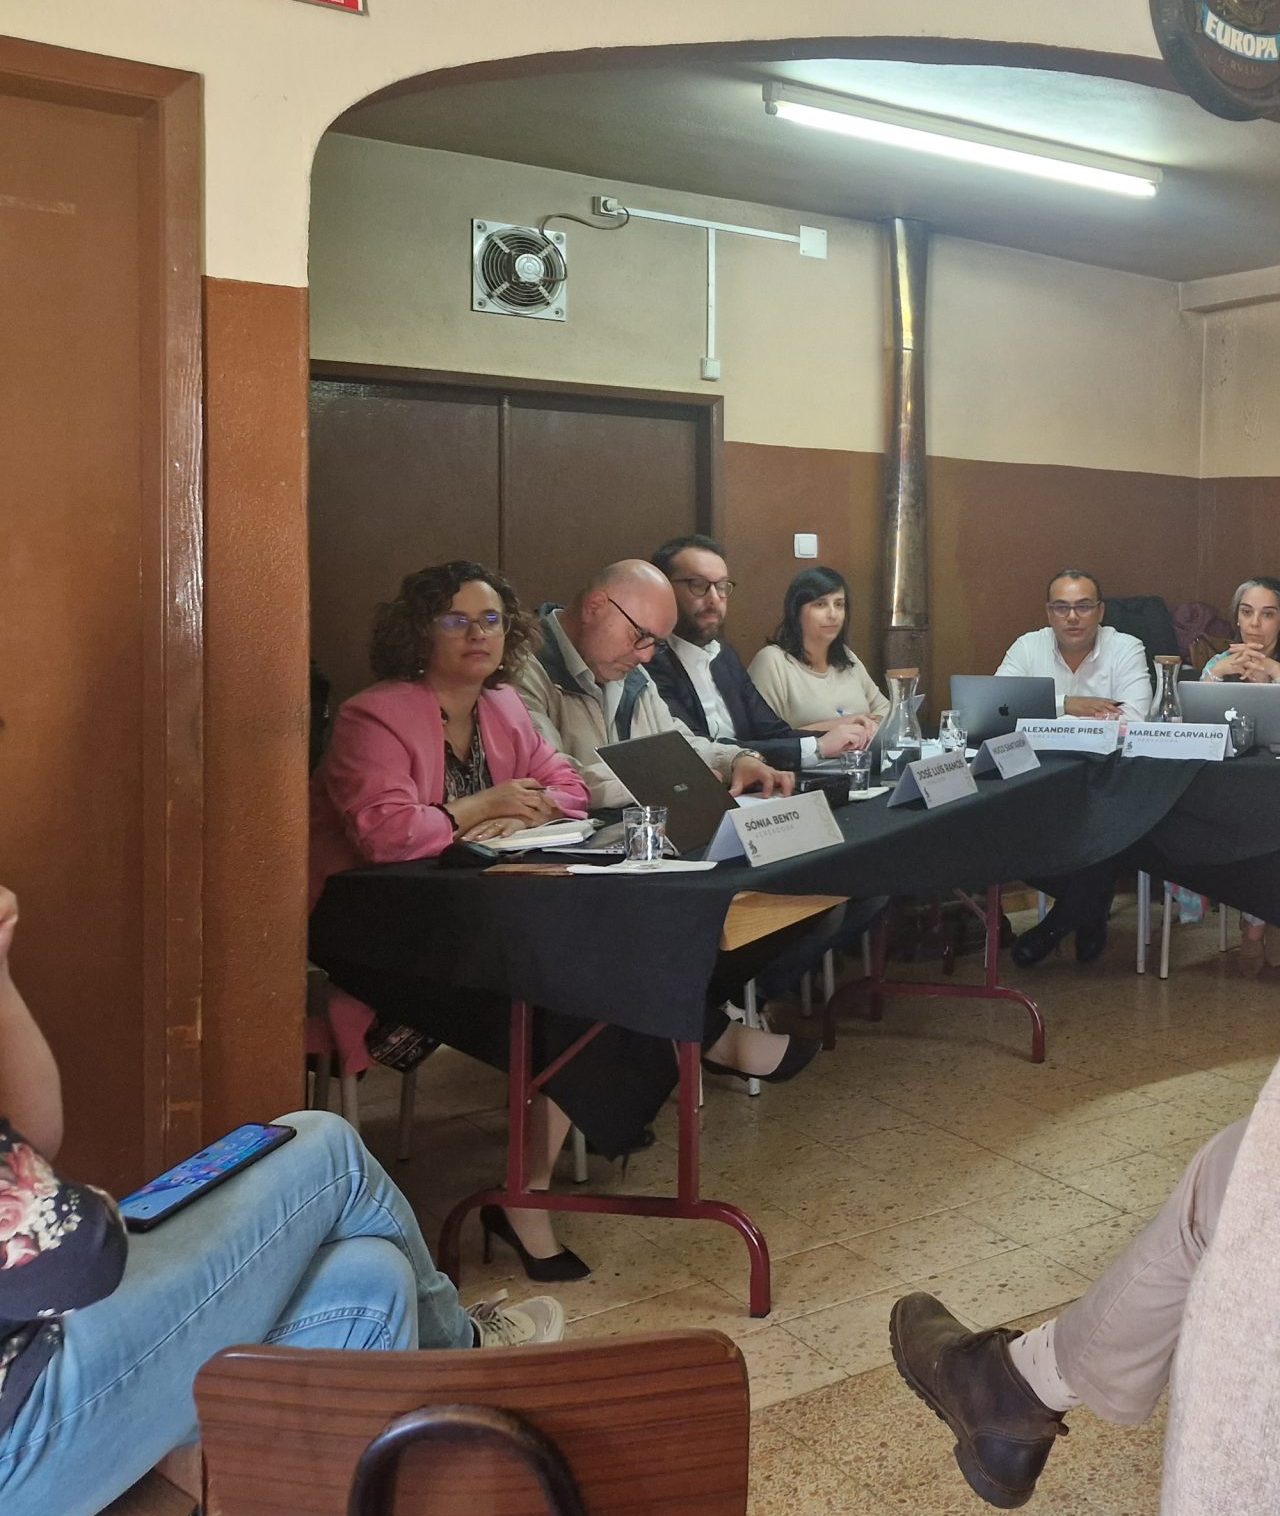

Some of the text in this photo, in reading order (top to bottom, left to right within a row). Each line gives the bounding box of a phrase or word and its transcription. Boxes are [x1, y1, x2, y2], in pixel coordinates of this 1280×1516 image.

[1205, 11, 1278, 59] EUROPA
[1021, 726, 1104, 735] ALEXANDRE PIRES
[1129, 729, 1224, 739] MARLENE CARVALHO
[917, 767, 933, 780] JOSÉ
[933, 764, 946, 777] LUÍS
[945, 759, 965, 774] RAMOS
[772, 810, 800, 825] BENTO
